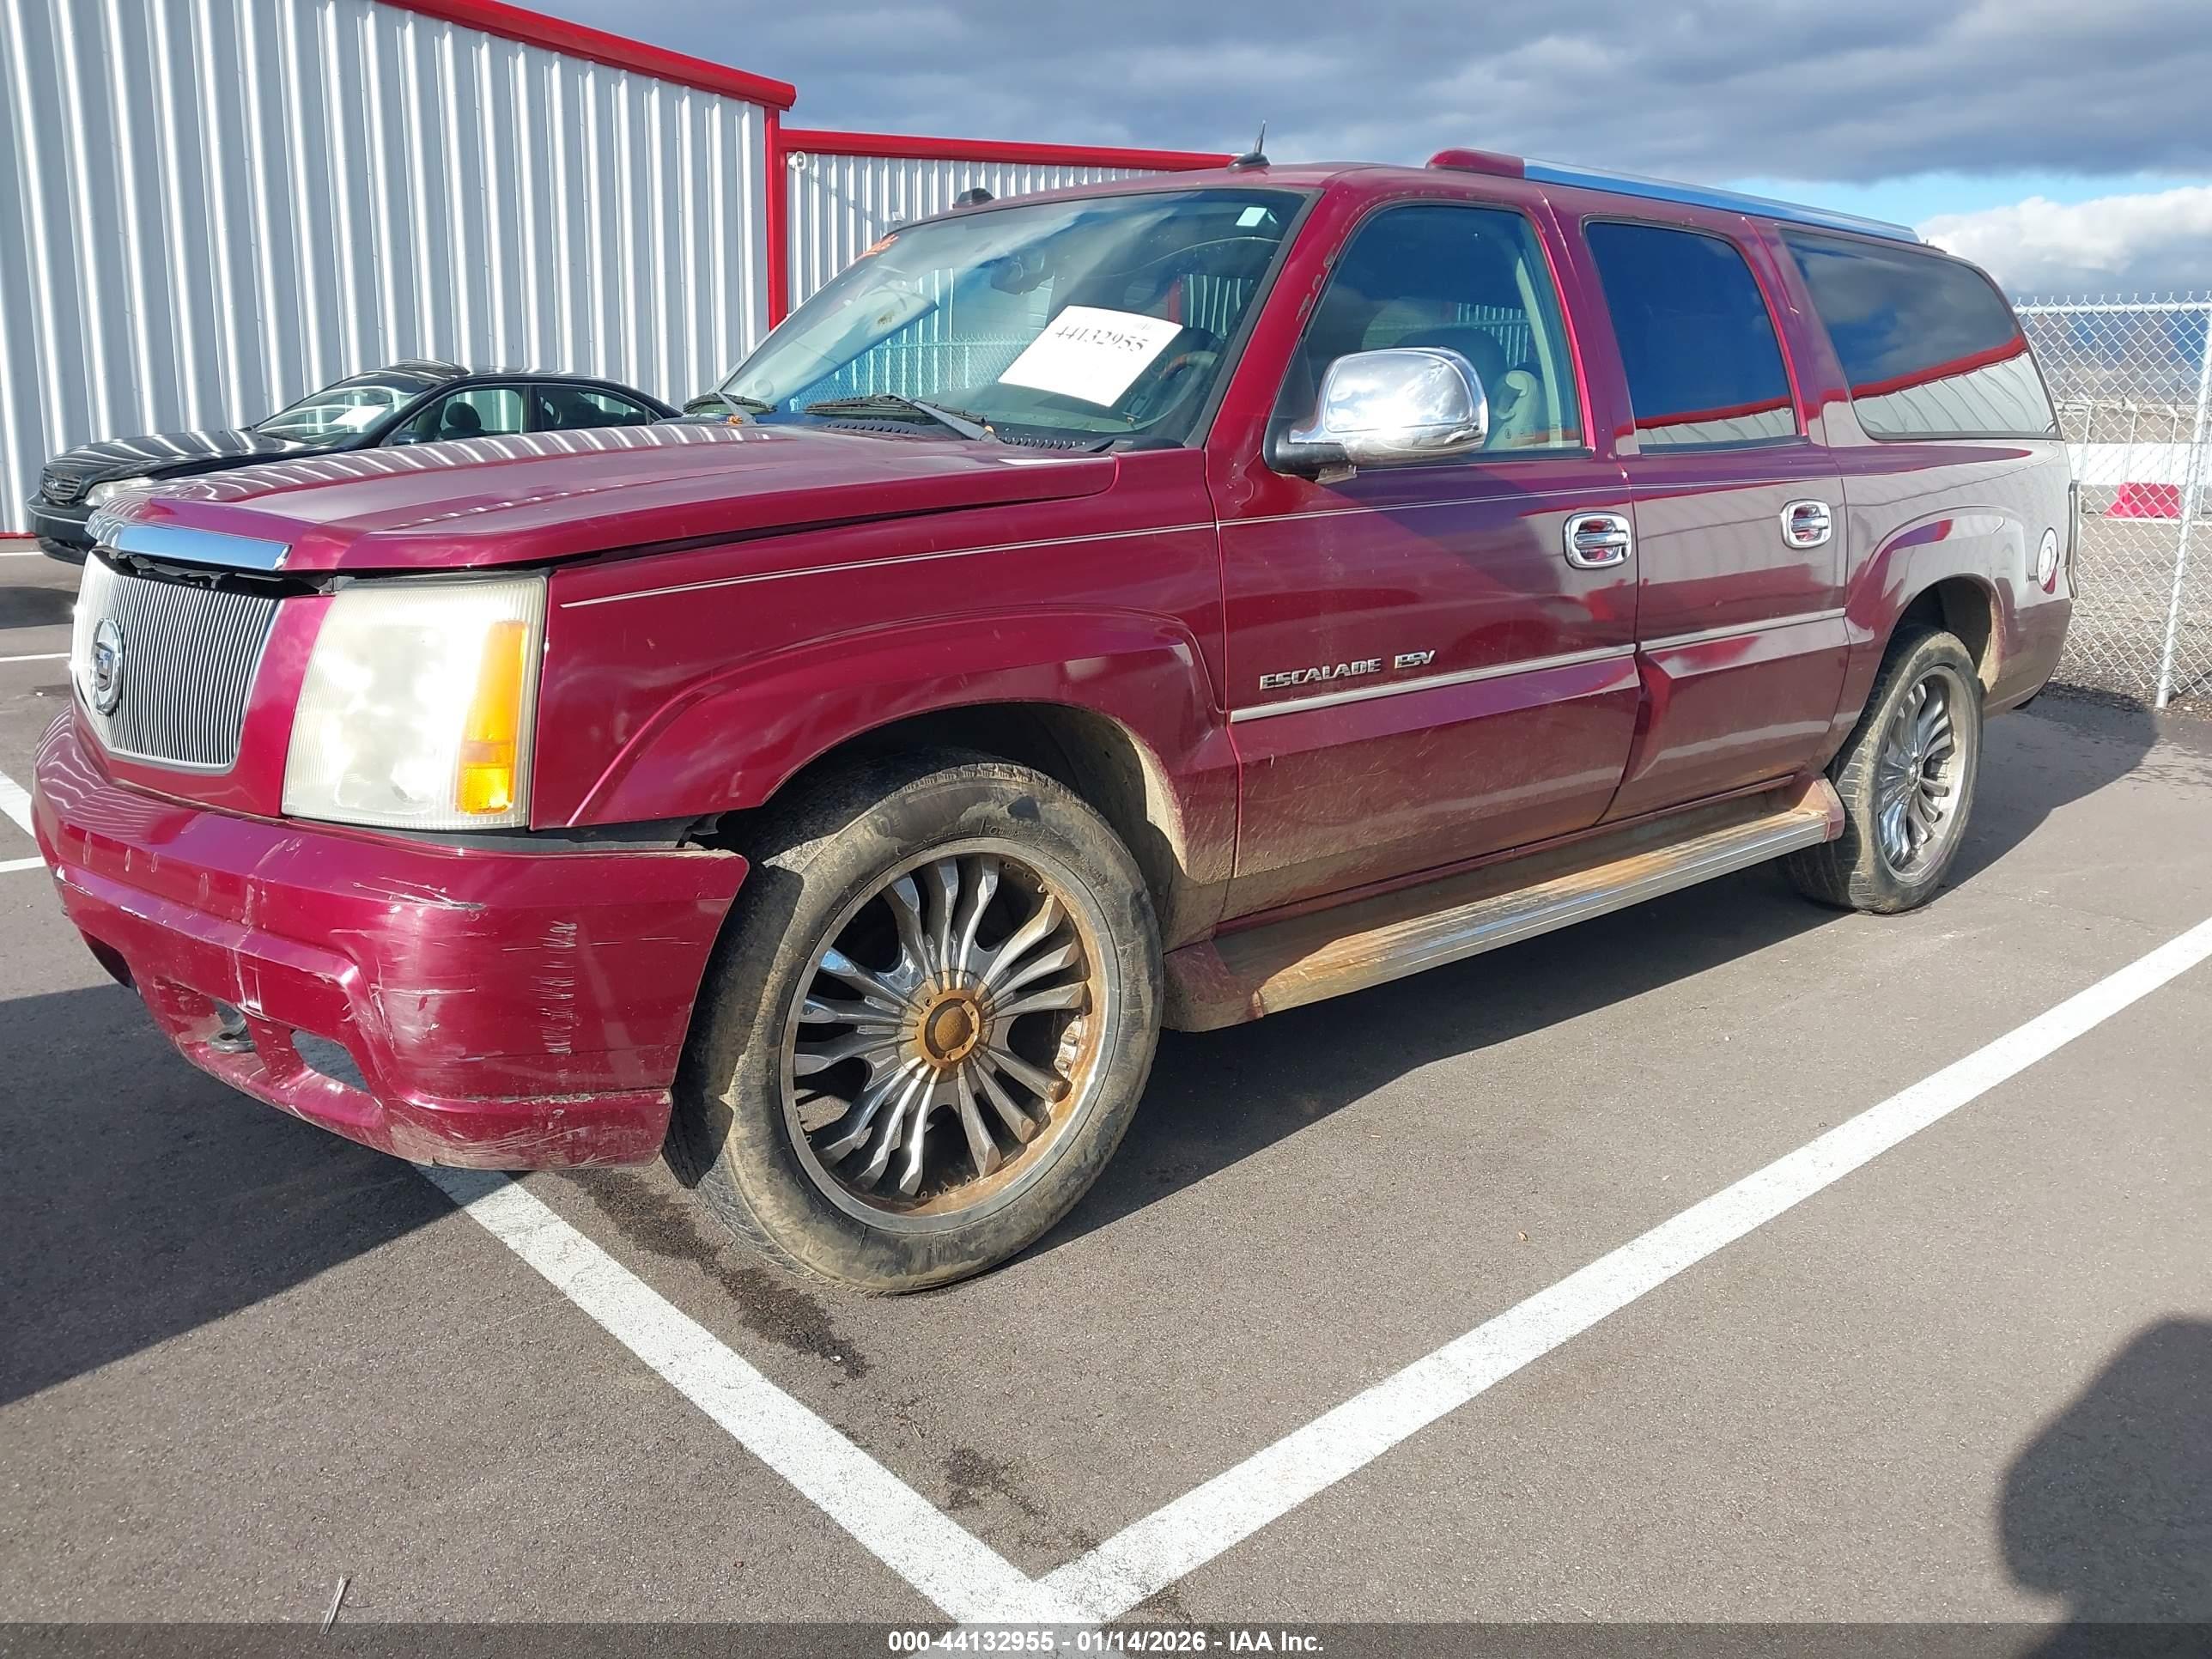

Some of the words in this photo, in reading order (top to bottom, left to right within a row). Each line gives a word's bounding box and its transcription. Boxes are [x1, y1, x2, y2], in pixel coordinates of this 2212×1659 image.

[1055, 325, 1149, 353] 44132955
[1259, 658, 1382, 690] ESCALADE
[1395, 650, 1436, 669] ESV
